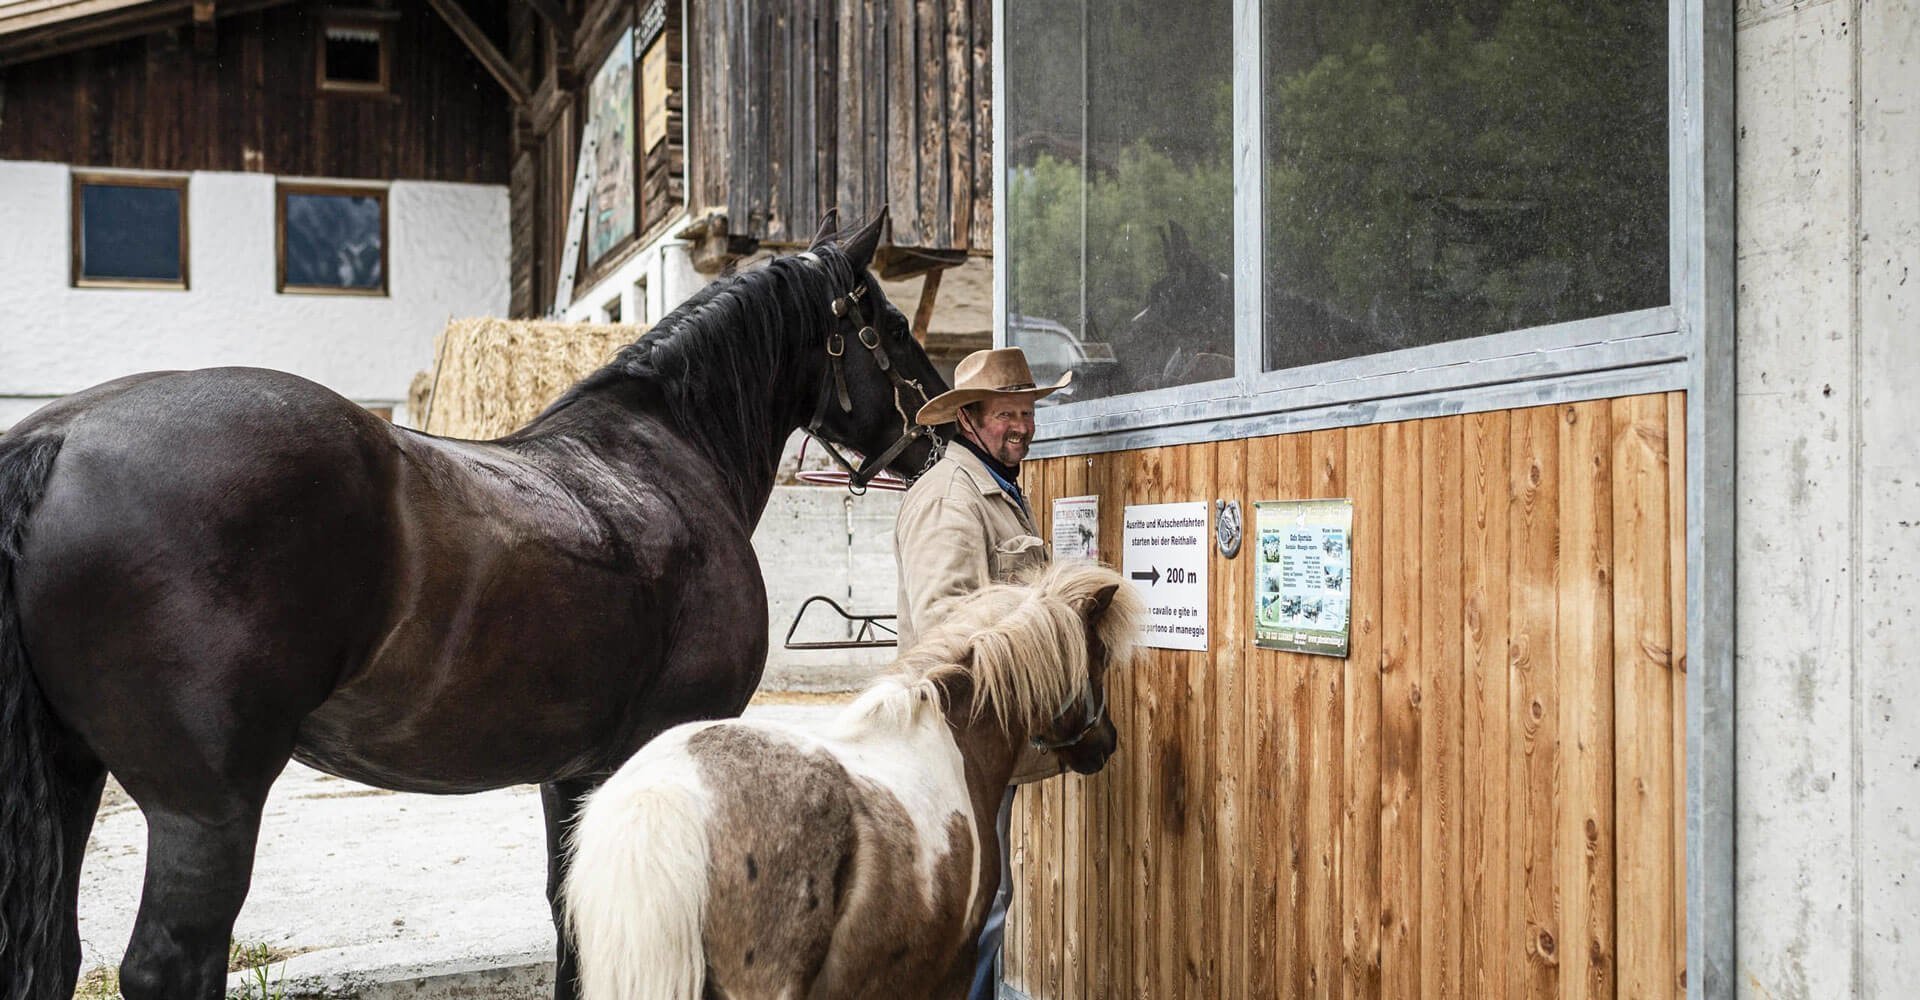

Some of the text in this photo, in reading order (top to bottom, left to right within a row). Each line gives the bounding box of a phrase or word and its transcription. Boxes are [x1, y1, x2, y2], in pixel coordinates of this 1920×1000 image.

[1126, 517, 1205, 529] Ausritte und Kutschenfahrten
[1131, 535, 1197, 546] starten bei der Reithalle
[1166, 567, 1197, 584] 200 m
[1152, 605, 1172, 616] cavallo
[1173, 608, 1177, 616] e
[1178, 606, 1190, 618] gite
[1191, 606, 1198, 616] in
[1168, 624, 1175, 633] al
[1175, 625, 1205, 637] maneggio
